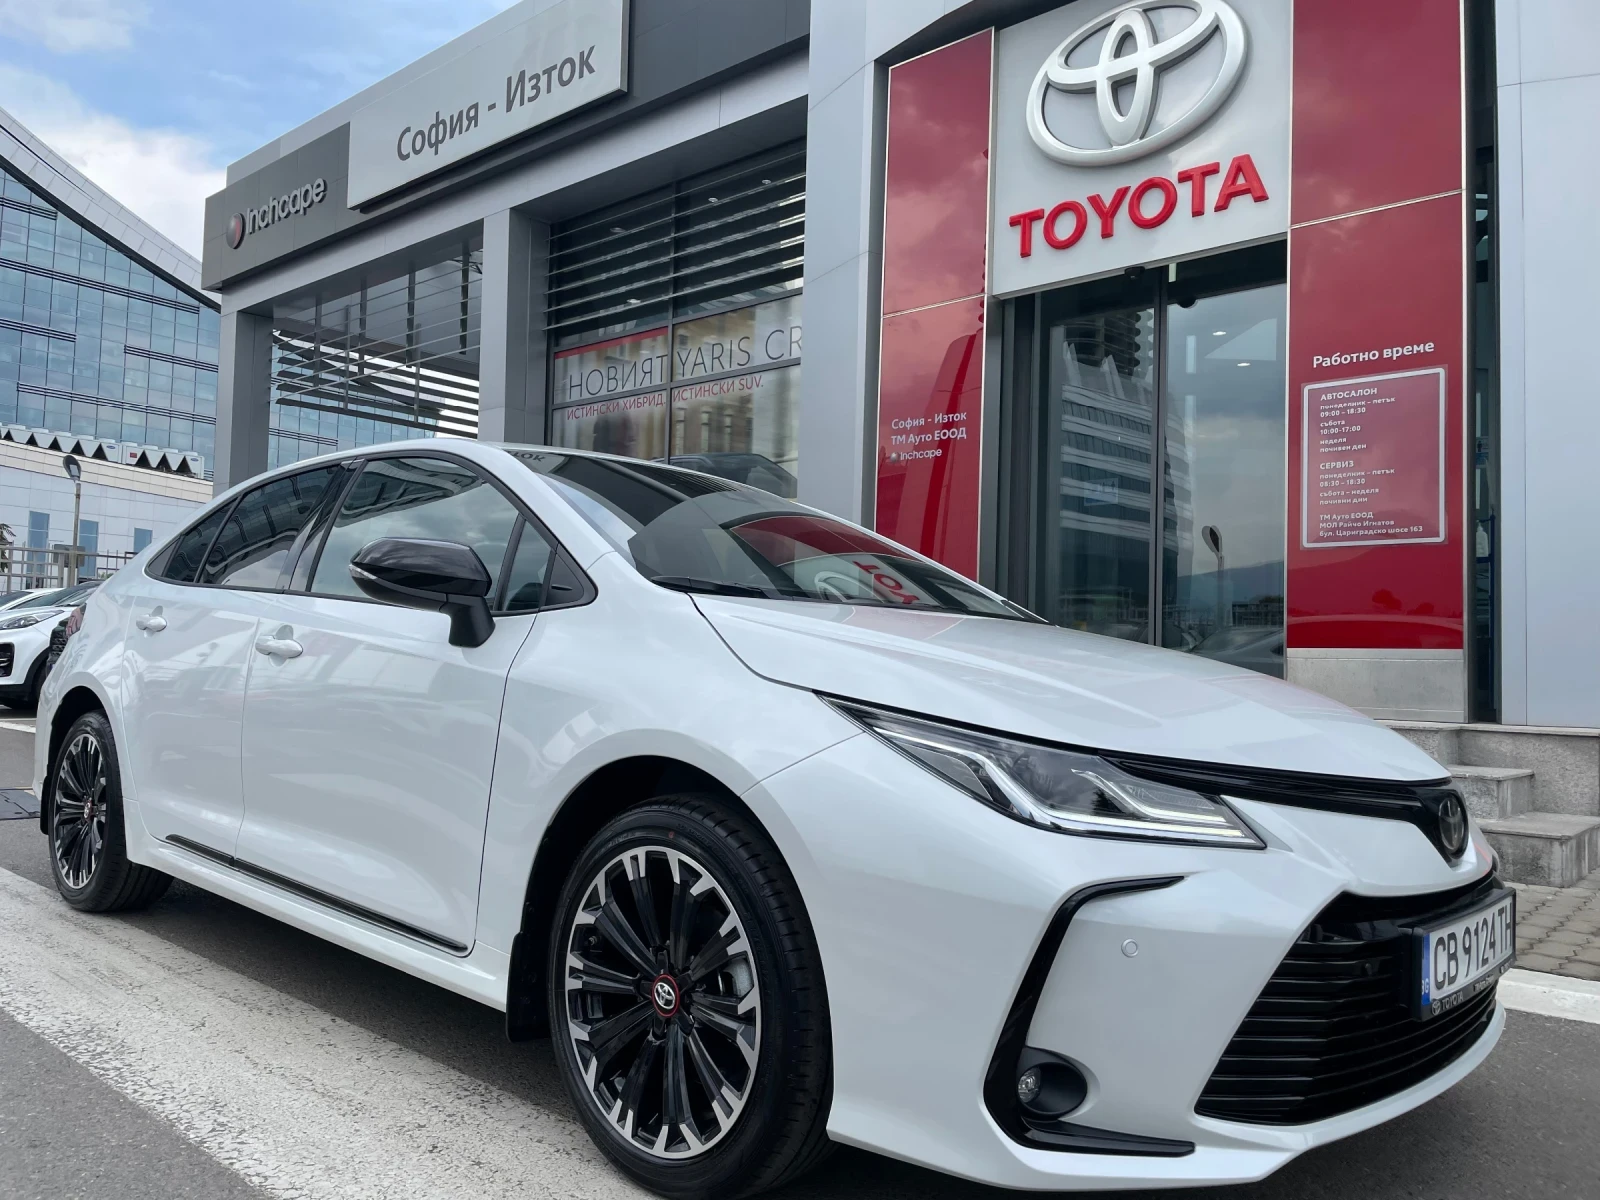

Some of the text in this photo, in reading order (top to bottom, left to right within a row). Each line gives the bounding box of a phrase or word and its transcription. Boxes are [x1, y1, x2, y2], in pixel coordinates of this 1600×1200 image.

[396, 102, 479, 161] София
[505, 45, 596, 113] Изток
[246, 177, 325, 234] Inchcape
[1009, 153, 1269, 258] TOYOTA
[1313, 341, 1435, 368] Работно време
[568, 325, 802, 400] НОВИЯТ YARIS CR
[567, 375, 764, 421] ИСТИНСКИ ХИБРИД. ИСТИНСКИ SUV.
[1320, 388, 1378, 401] АВТОСАЛОН
[1320, 400, 1366, 410] понеделник
[1320, 410, 1340, 418] 09:00
[1346, 407, 1366, 415] 18:30
[891, 417, 925, 430] София
[934, 412, 967, 424] Изток
[1320, 425, 1361, 435] 10:00-17:00
[891, 427, 967, 446] ТМ Ауто ЕООД
[1320, 437, 1347, 445] неделя
[900, 448, 942, 460] Inchcape
[1320, 443, 1367, 453] почивен ден
[1320, 460, 1354, 470] СЕРВИЗ
[1320, 471, 1365, 480] понеделник
[1332, 513, 1350, 521] Ауто
[1320, 519, 1395, 529] МОЛ Райчо Игнатов
[1320, 530, 1335, 538] бул.
[1336, 528, 1387, 537] Цариградско
[1387, 526, 1409, 534] шосе
[1434, 901, 1512, 991] CB 9124 TH
[1441, 991, 1464, 1011] TOYOTA
